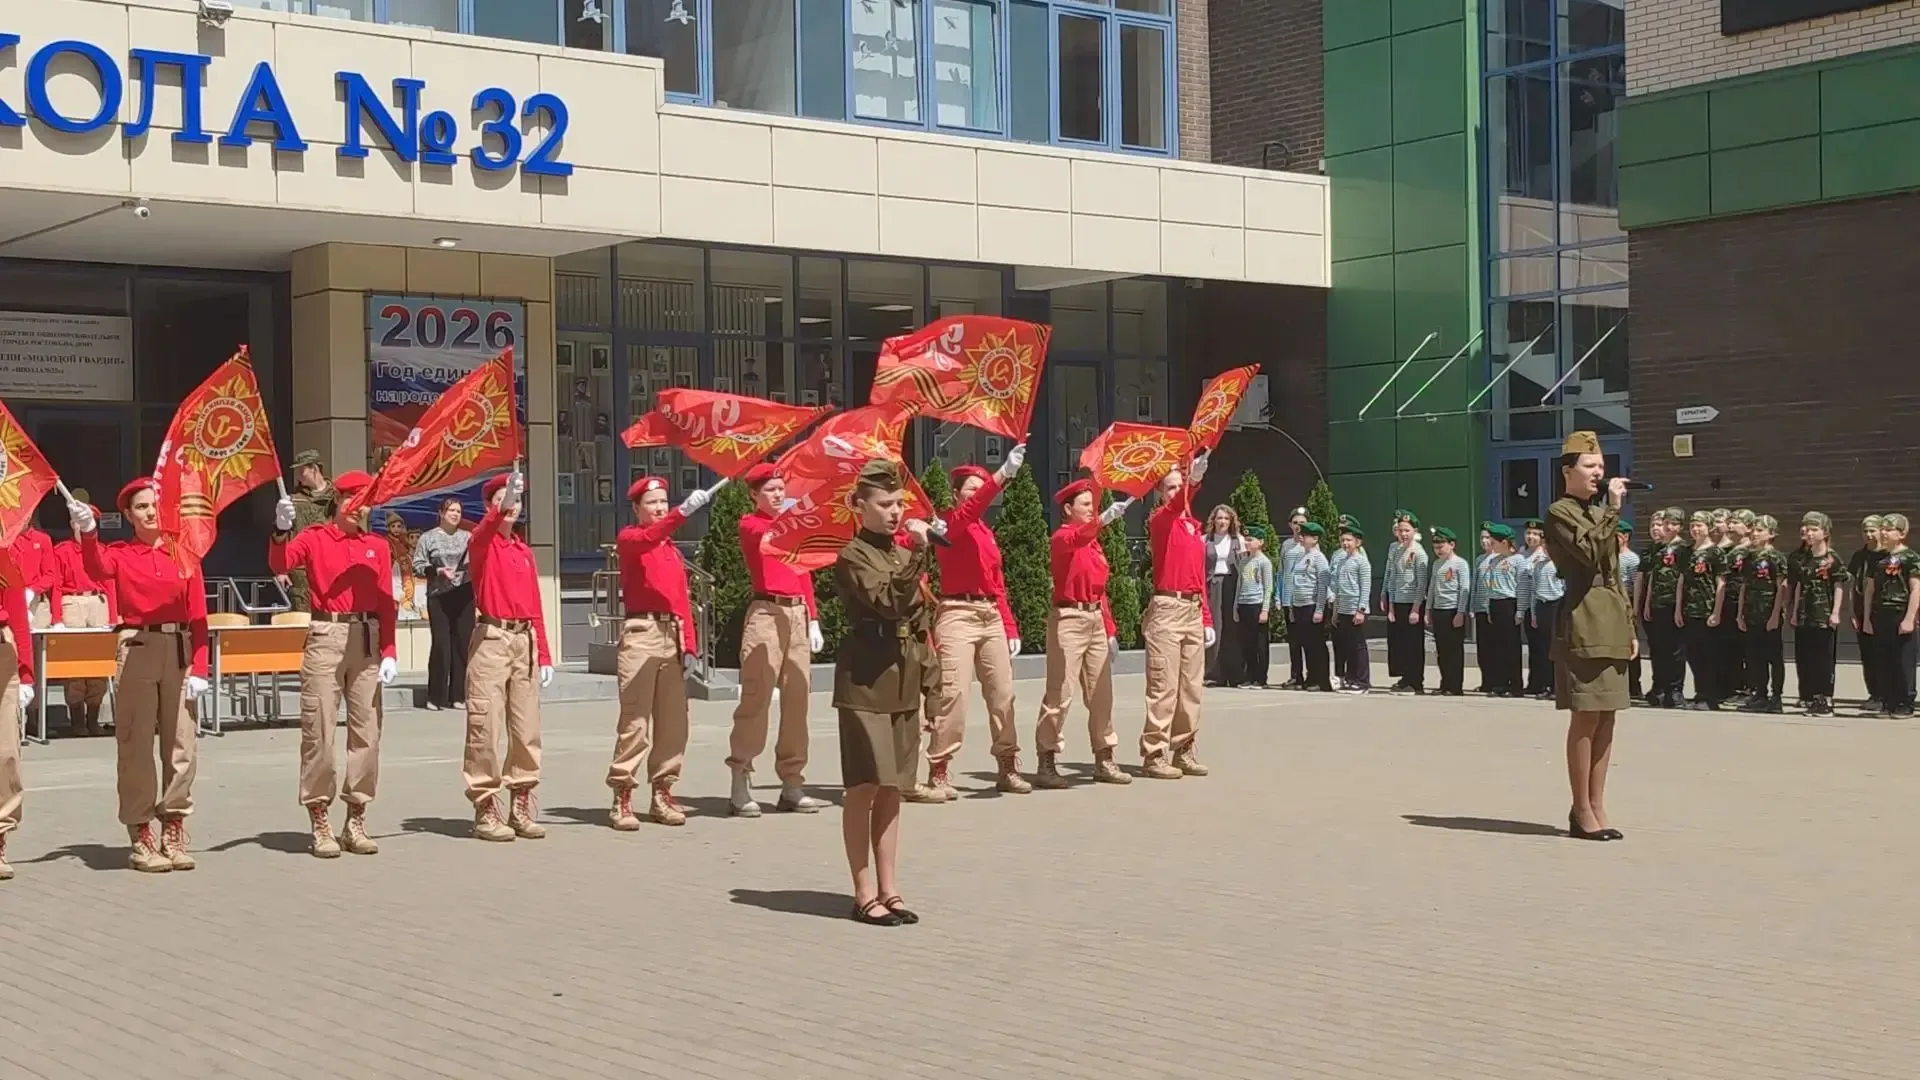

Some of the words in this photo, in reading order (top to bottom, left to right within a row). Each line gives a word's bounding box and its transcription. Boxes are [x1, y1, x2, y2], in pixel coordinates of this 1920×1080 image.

[381, 305, 515, 350] 2026
[376, 361, 414, 382] Год
[375, 390, 445, 407] народо
